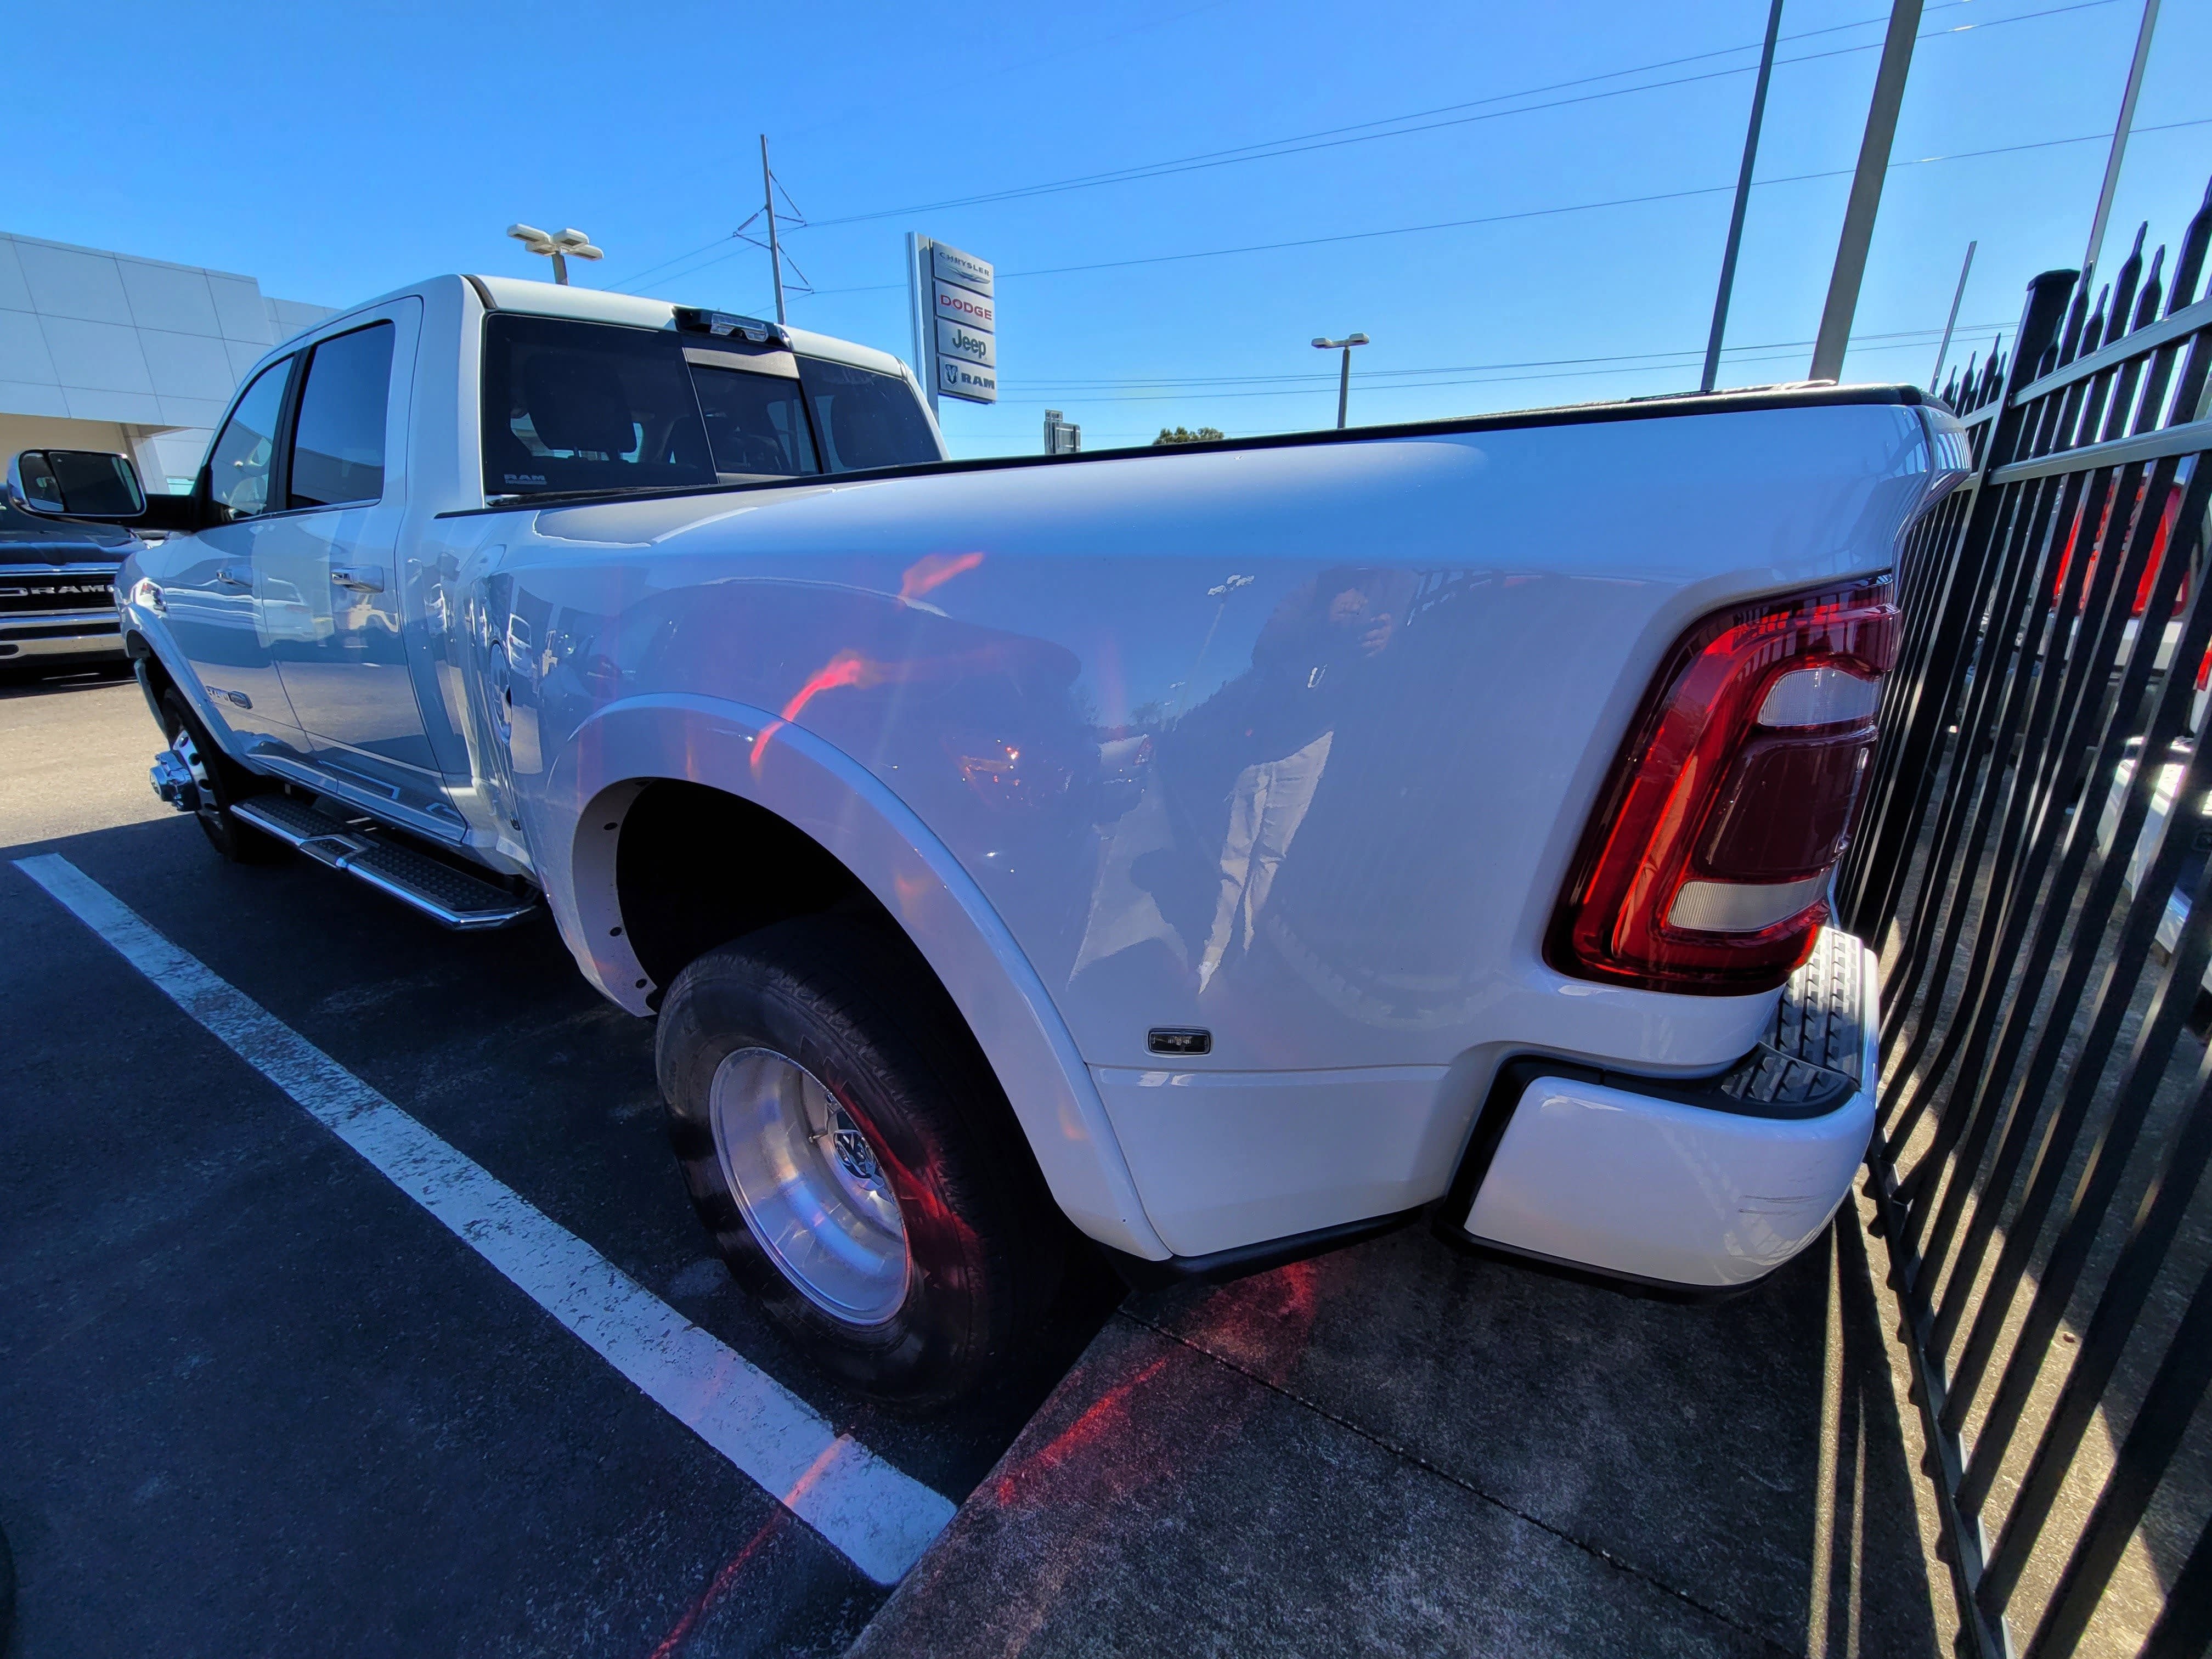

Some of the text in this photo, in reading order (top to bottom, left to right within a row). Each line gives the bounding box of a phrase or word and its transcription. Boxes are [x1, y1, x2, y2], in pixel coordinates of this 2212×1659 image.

[939, 252, 990, 276] CHRYSLER
[940, 294, 992, 320] DODGE
[952, 329, 986, 358] Jeep
[961, 372, 995, 390] RAM
[31, 585, 105, 594] RAM
